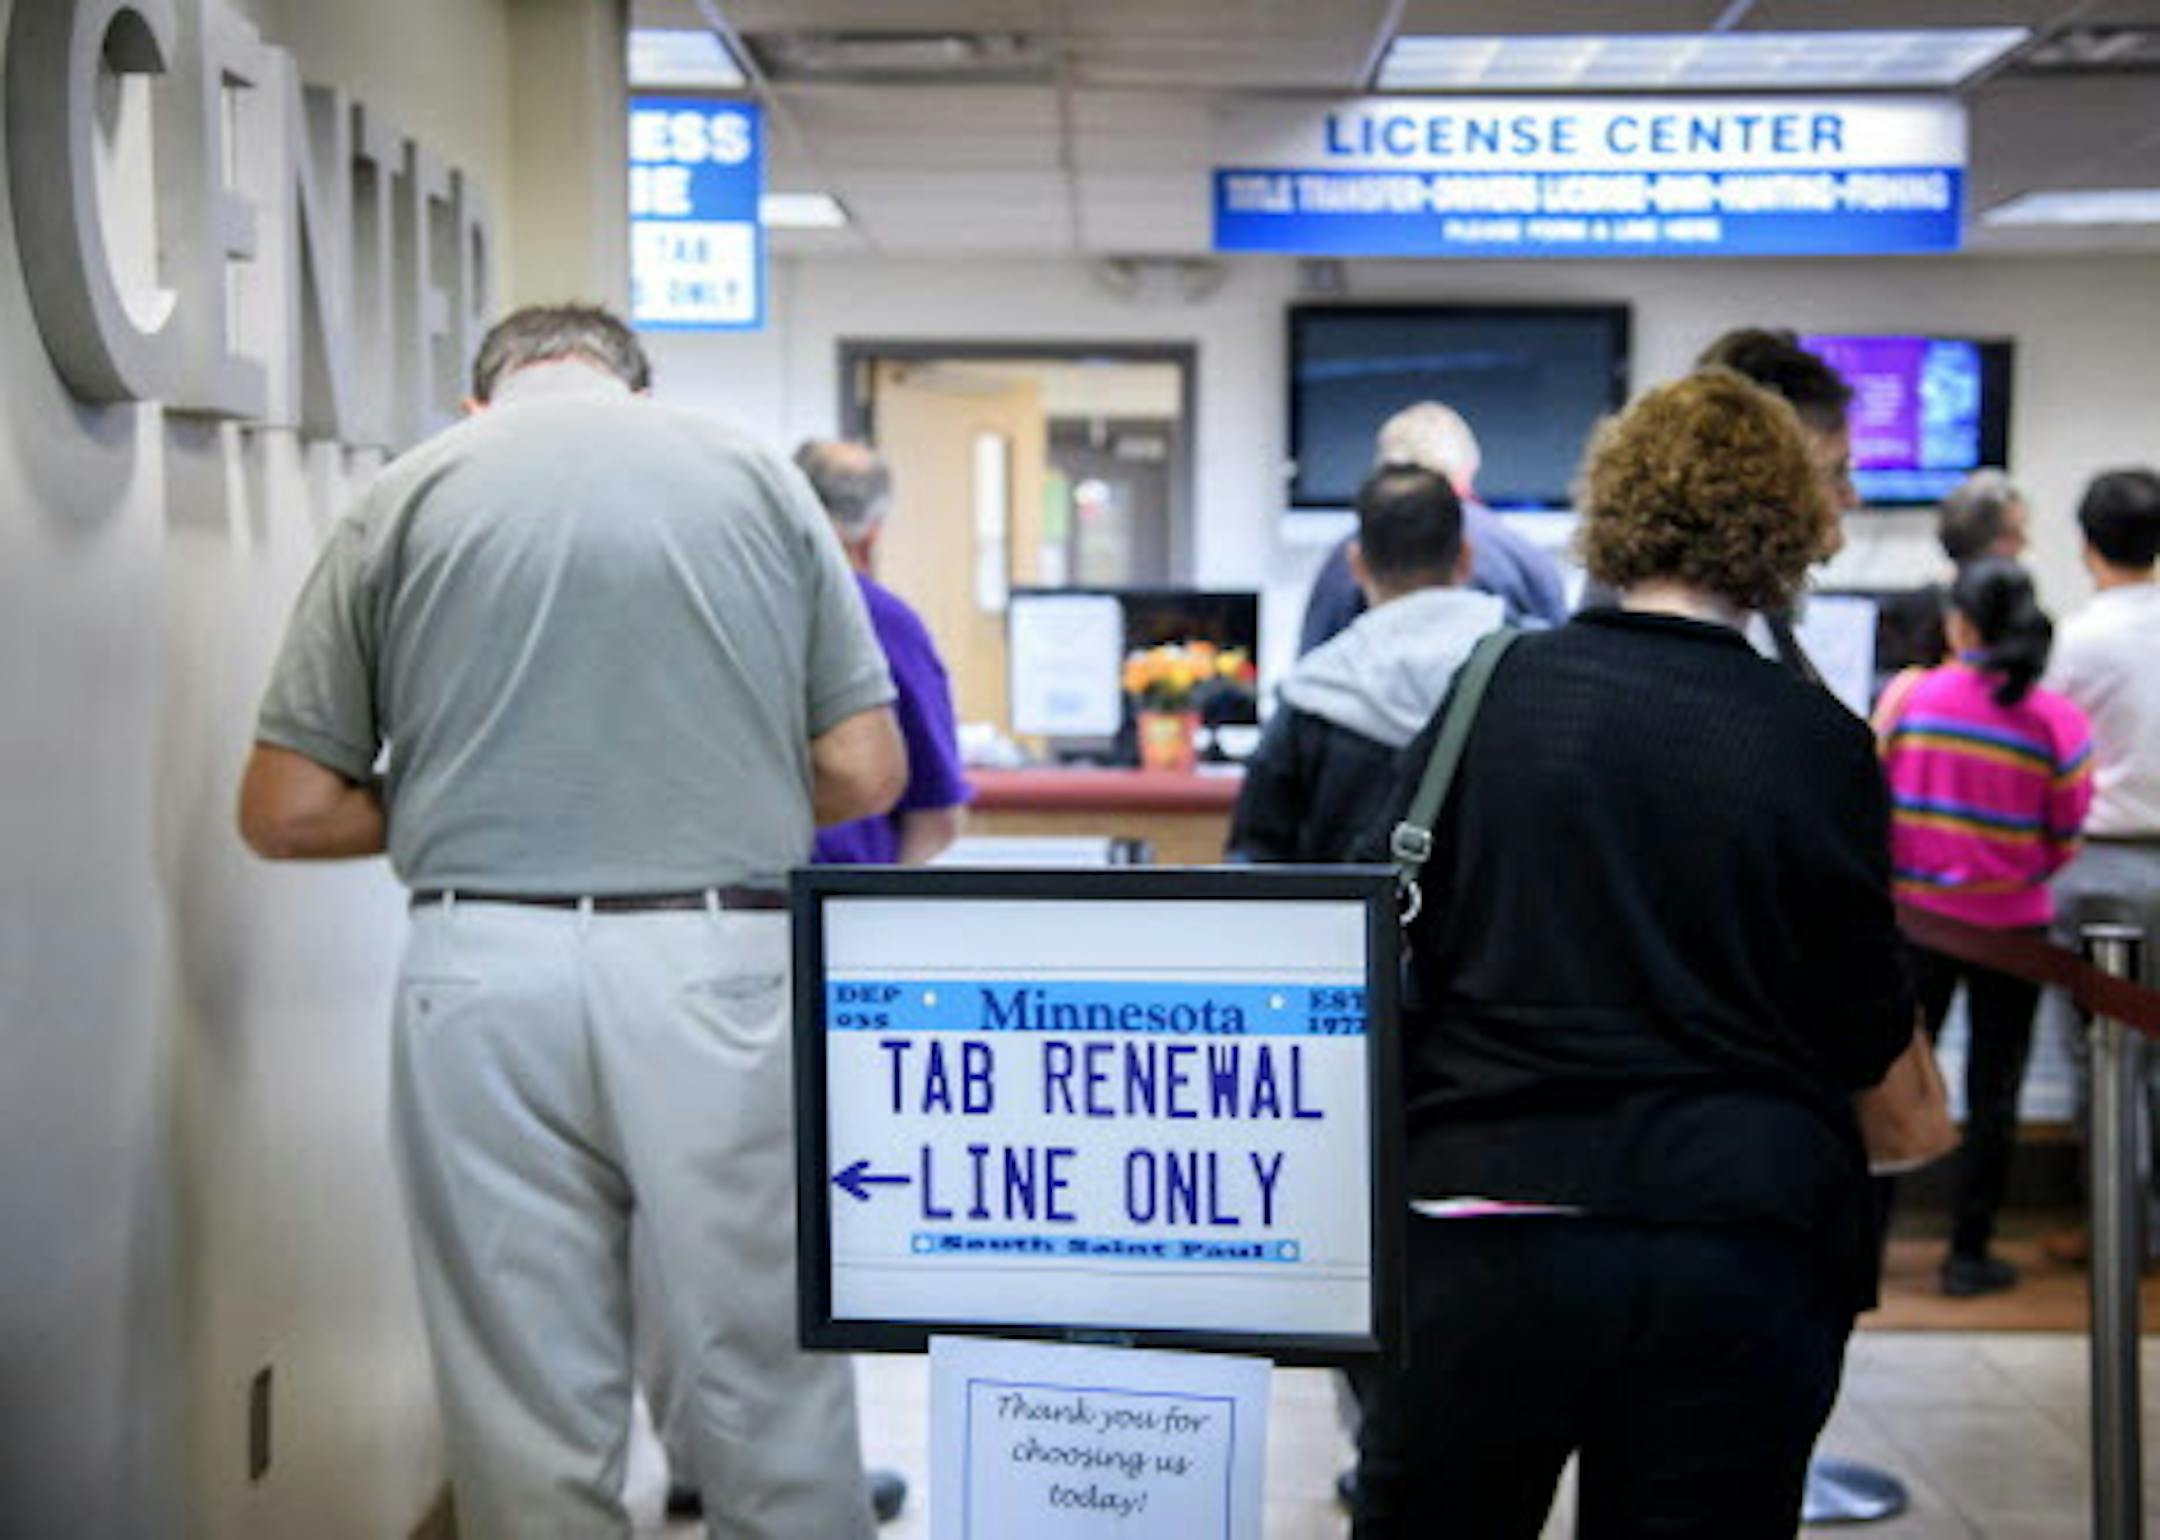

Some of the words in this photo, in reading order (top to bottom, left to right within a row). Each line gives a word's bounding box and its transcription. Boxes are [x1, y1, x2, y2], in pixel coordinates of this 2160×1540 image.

[1325, 112, 1578, 156] LICENSE
[1604, 112, 1845, 154] CENTER
[837, 985, 901, 1003] DEP
[980, 988, 1247, 1034] Minnesota
[837, 1013, 890, 1029] 035
[880, 1039, 995, 1115] TAB
[1042, 1041, 1324, 1120] RENEWAL
[920, 1144, 1077, 1222] LINE
[1124, 1147, 1284, 1227] ONLY
[939, 1234, 1053, 1254] South
[1067, 1238, 1166, 1257] Saint
[1182, 1241, 1265, 1258] Paul
[996, 1393, 1096, 1425] Thank
[1098, 1408, 1160, 1434] you
[1162, 1406, 1210, 1434] for
[1011, 1437, 1148, 1479] choosing
[1154, 1457, 1193, 1476] us
[1048, 1483, 1149, 1517] today!
